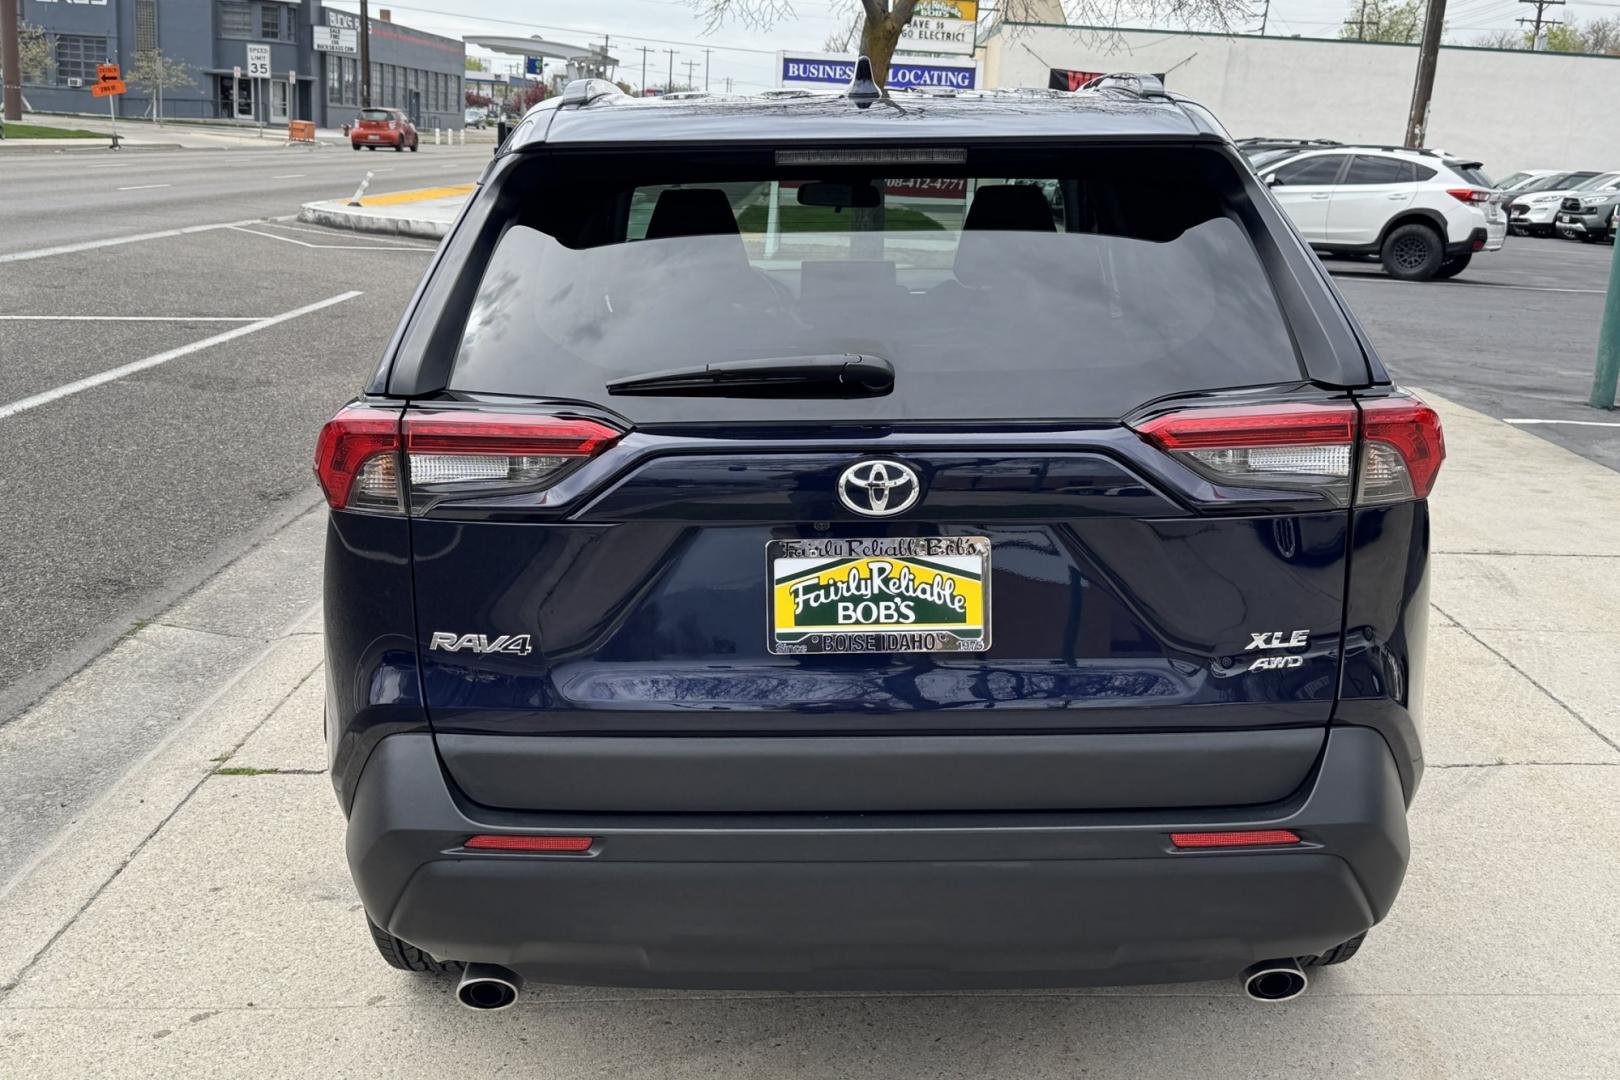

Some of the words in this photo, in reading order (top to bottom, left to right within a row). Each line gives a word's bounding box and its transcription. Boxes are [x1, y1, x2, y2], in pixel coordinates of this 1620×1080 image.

[901, 29, 914, 38] GO
[250, 62, 268, 74] 35
[788, 63, 854, 80] BUSINES
[885, 178, 965, 190] 08-412-4771
[789, 567, 872, 615] Fairly
[868, 561, 968, 613] Reliable
[838, 597, 917, 624] BOB'S
[429, 631, 532, 656] RAV4
[822, 634, 877, 652] BOISE
[881, 633, 936, 651] IDAHO
[1244, 629, 1311, 650] XLE
[1247, 655, 1304, 671] AWD
